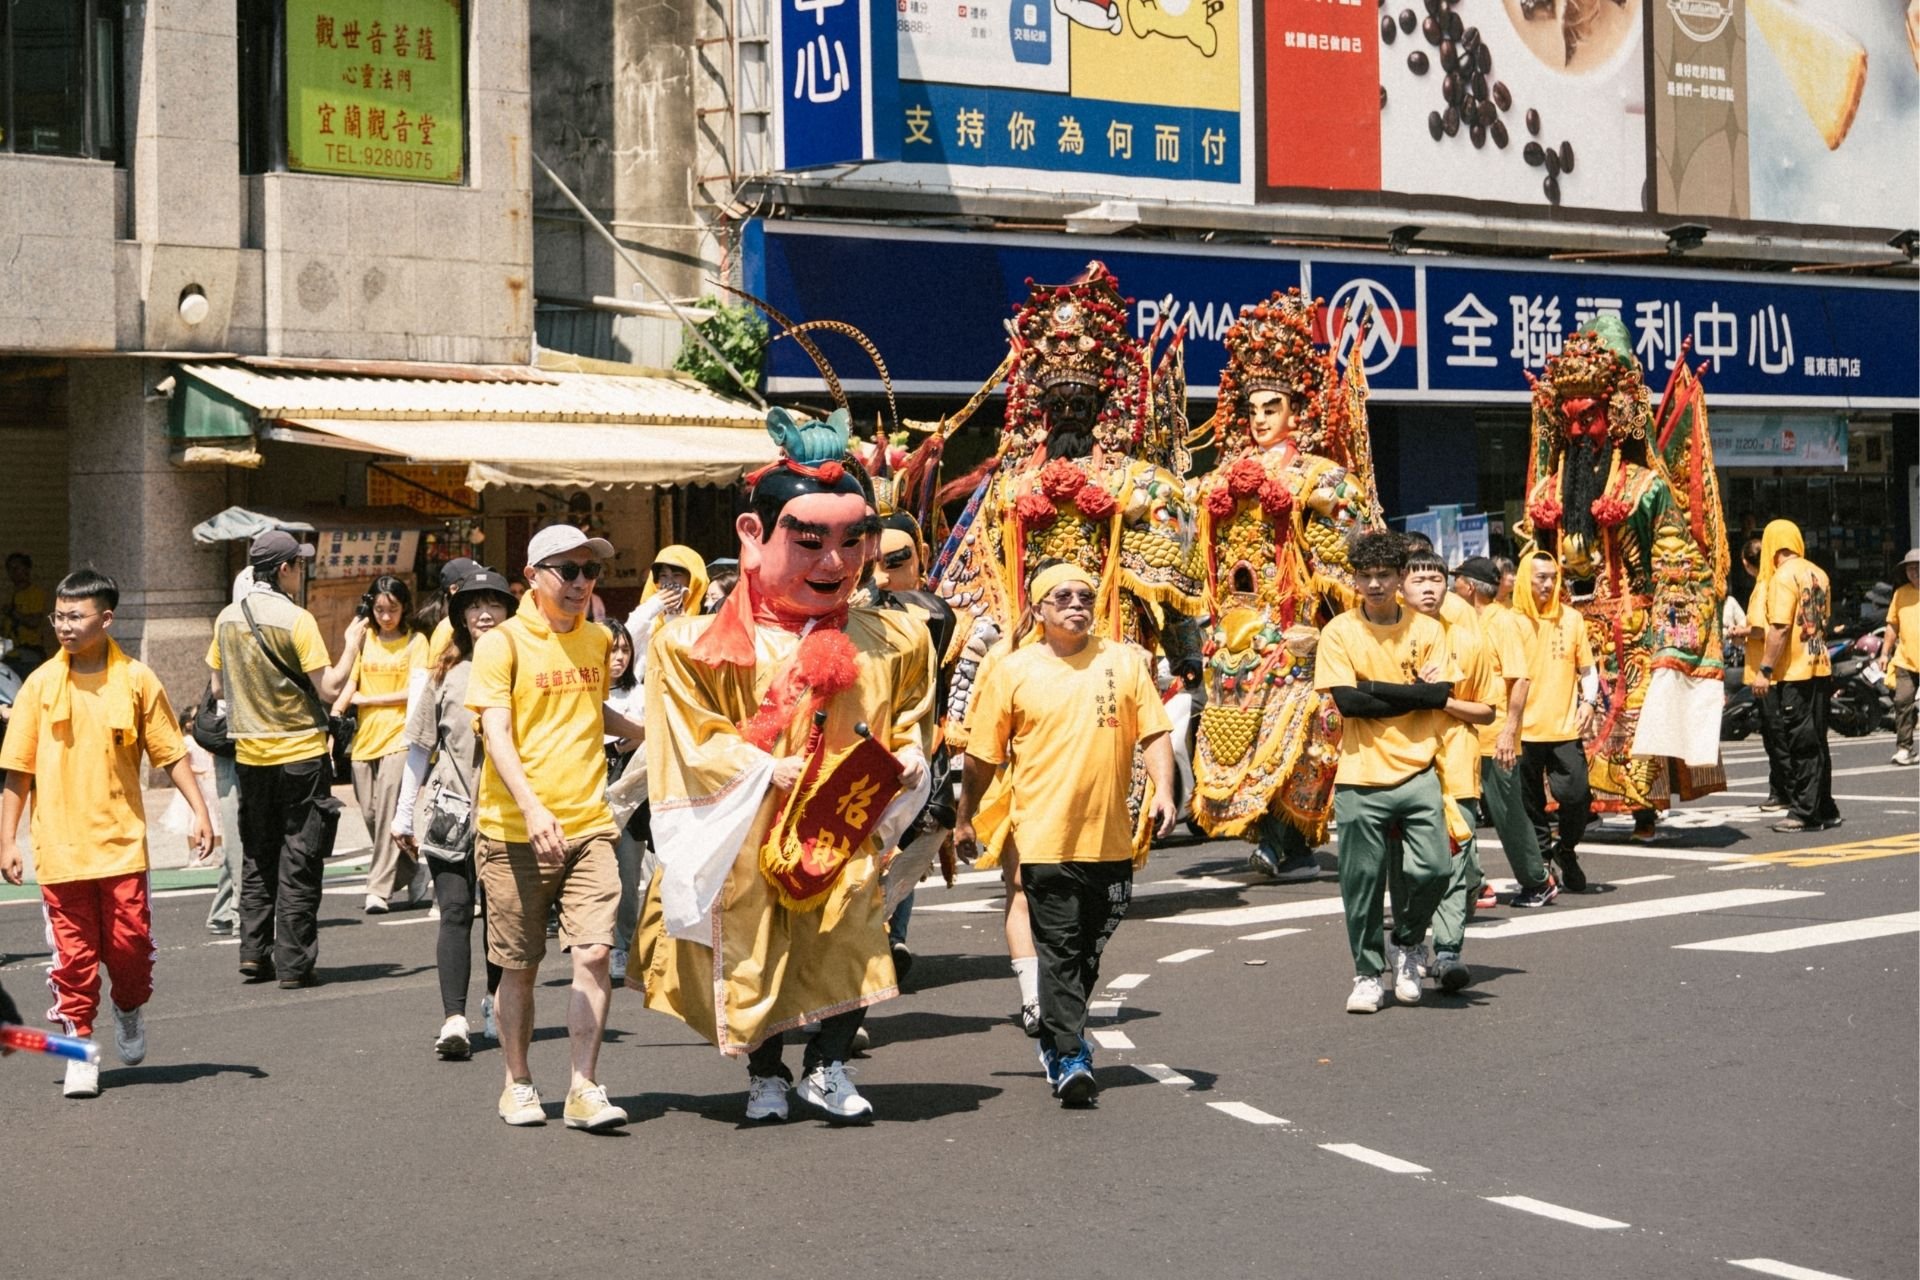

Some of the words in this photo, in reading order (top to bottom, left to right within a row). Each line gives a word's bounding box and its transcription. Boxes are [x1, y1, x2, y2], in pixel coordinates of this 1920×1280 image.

[315, 14, 436, 61] 觀世音菩薩
[342, 63, 412, 92] 心靈法門
[318, 102, 437, 145] 宜蘭觀音堂
[904, 104, 1227, 166] 支持你為何而付
[324, 143, 433, 170] TEL:9280875
[1804, 356, 1861, 377] 羅東南門店
[810, 773, 880, 875] 招財
